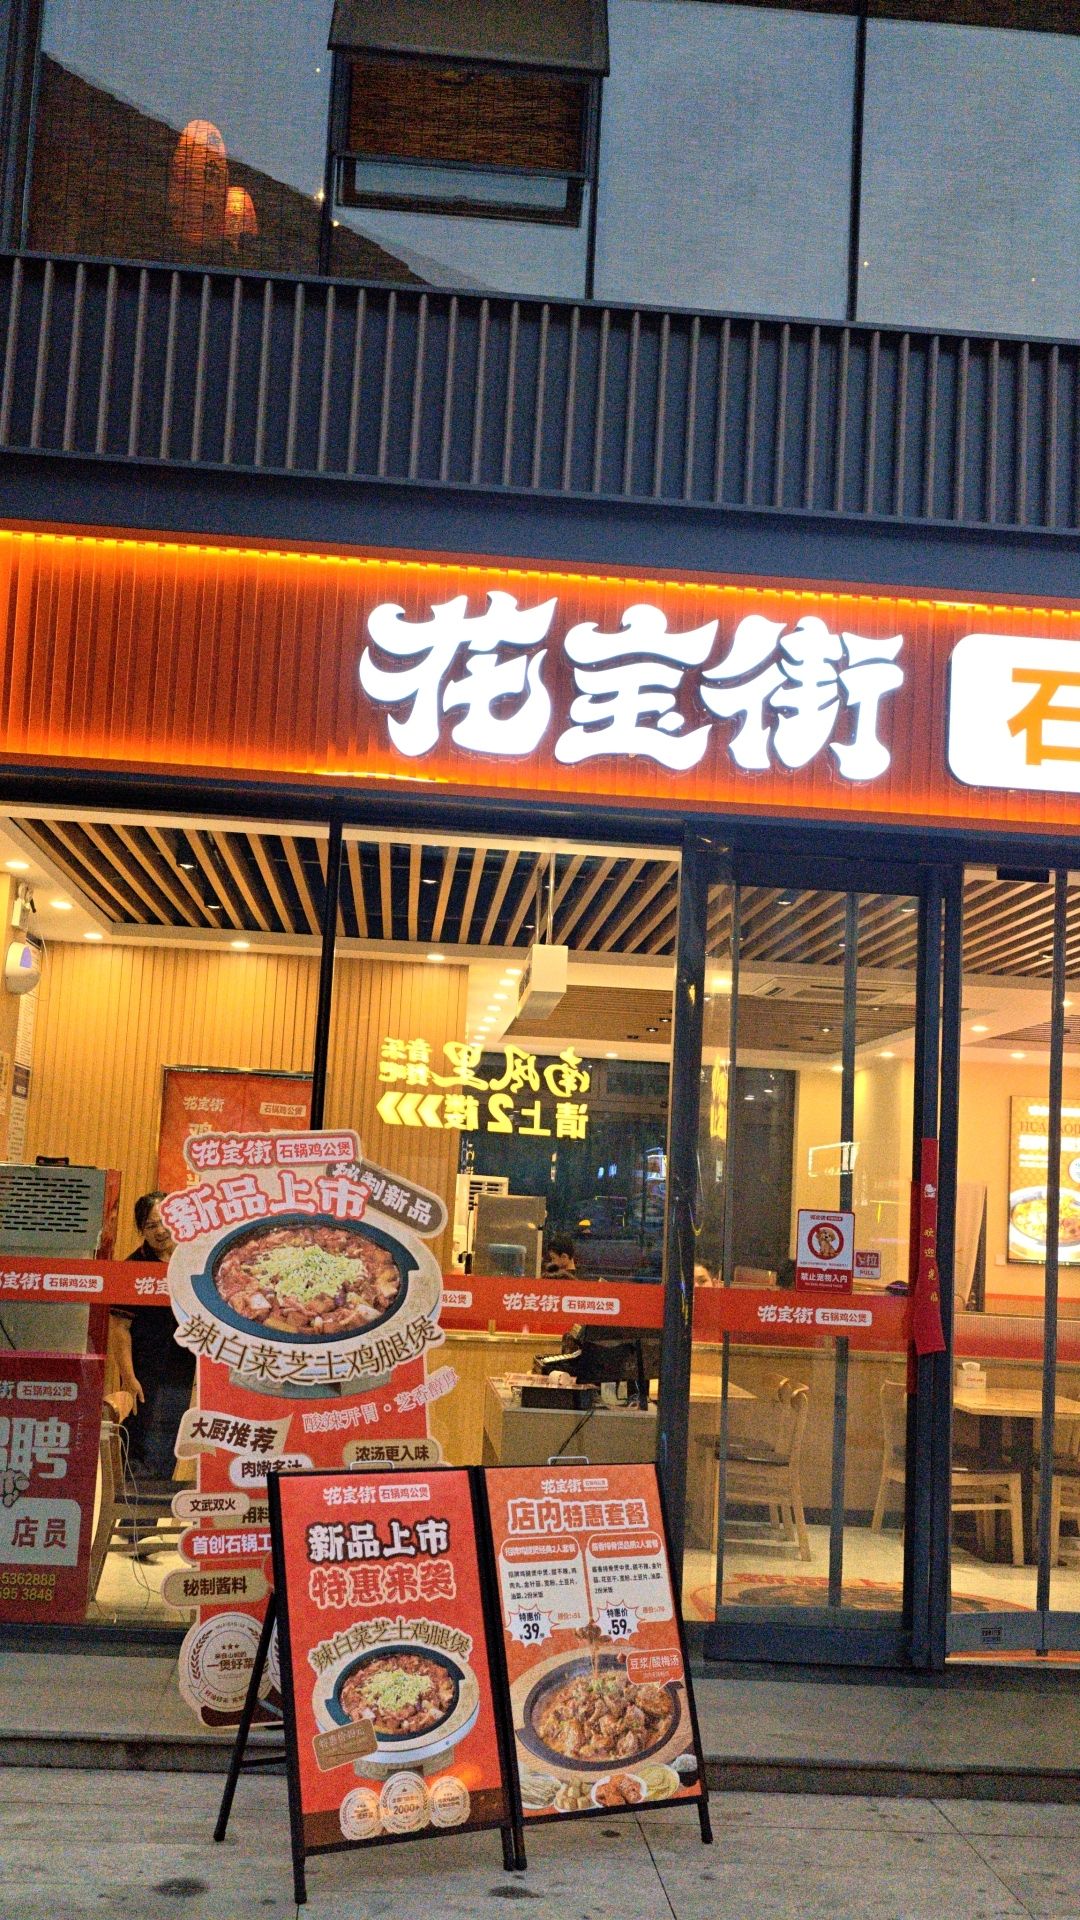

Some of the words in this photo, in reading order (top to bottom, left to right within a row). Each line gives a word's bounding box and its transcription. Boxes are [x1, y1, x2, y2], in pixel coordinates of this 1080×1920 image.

[358, 589, 905, 782] 花宝街
[1006, 666, 1080, 768] 石
[182, 1096, 225, 1113] 花宝街
[264, 1103, 304, 1116] 石锅鸡公煲
[191, 1138, 274, 1168] 花宝街
[279, 1141, 352, 1160] 石锅鸡公煲
[163, 1172, 370, 1240] 新品上市
[866, 1254, 879, 1267] 拉
[0, 1271, 42, 1291] 宝街
[48, 1277, 99, 1290] 石锅鸡公煲
[800, 1272, 849, 1284] 禁止宠物入内
[503, 1293, 562, 1312] 花宝街
[567, 1300, 614, 1312] 石锅鸡公煲
[757, 1304, 814, 1324] 花宝街
[820, 1309, 867, 1324] 石锅鸡公煲
[178, 1313, 441, 1384] 辣白菜芝士鸡腿煲
[22, 1385, 72, 1397] 石锅鸡公煲
[189, 1418, 278, 1454] 大厨推荐
[355, 1445, 430, 1461] 浓汤更入味
[323, 1486, 376, 1505] 花宝街
[380, 1487, 429, 1500] 石锅鸡公煲
[541, 1479, 582, 1494] 花宝街
[190, 1496, 236, 1511] 文武双火
[509, 1500, 649, 1533] 店内特惠套餐
[12, 1517, 68, 1549] 店员
[308, 1519, 449, 1562] 新品上市
[183, 1576, 247, 1597] 秘制酱料
[310, 1562, 455, 1606] 特惠来袭
[519, 1612, 541, 1622] 特惠价
[606, 1608, 628, 1618] 特惠价
[311, 1619, 471, 1672] 辣白菜芝士鸡腿煲
